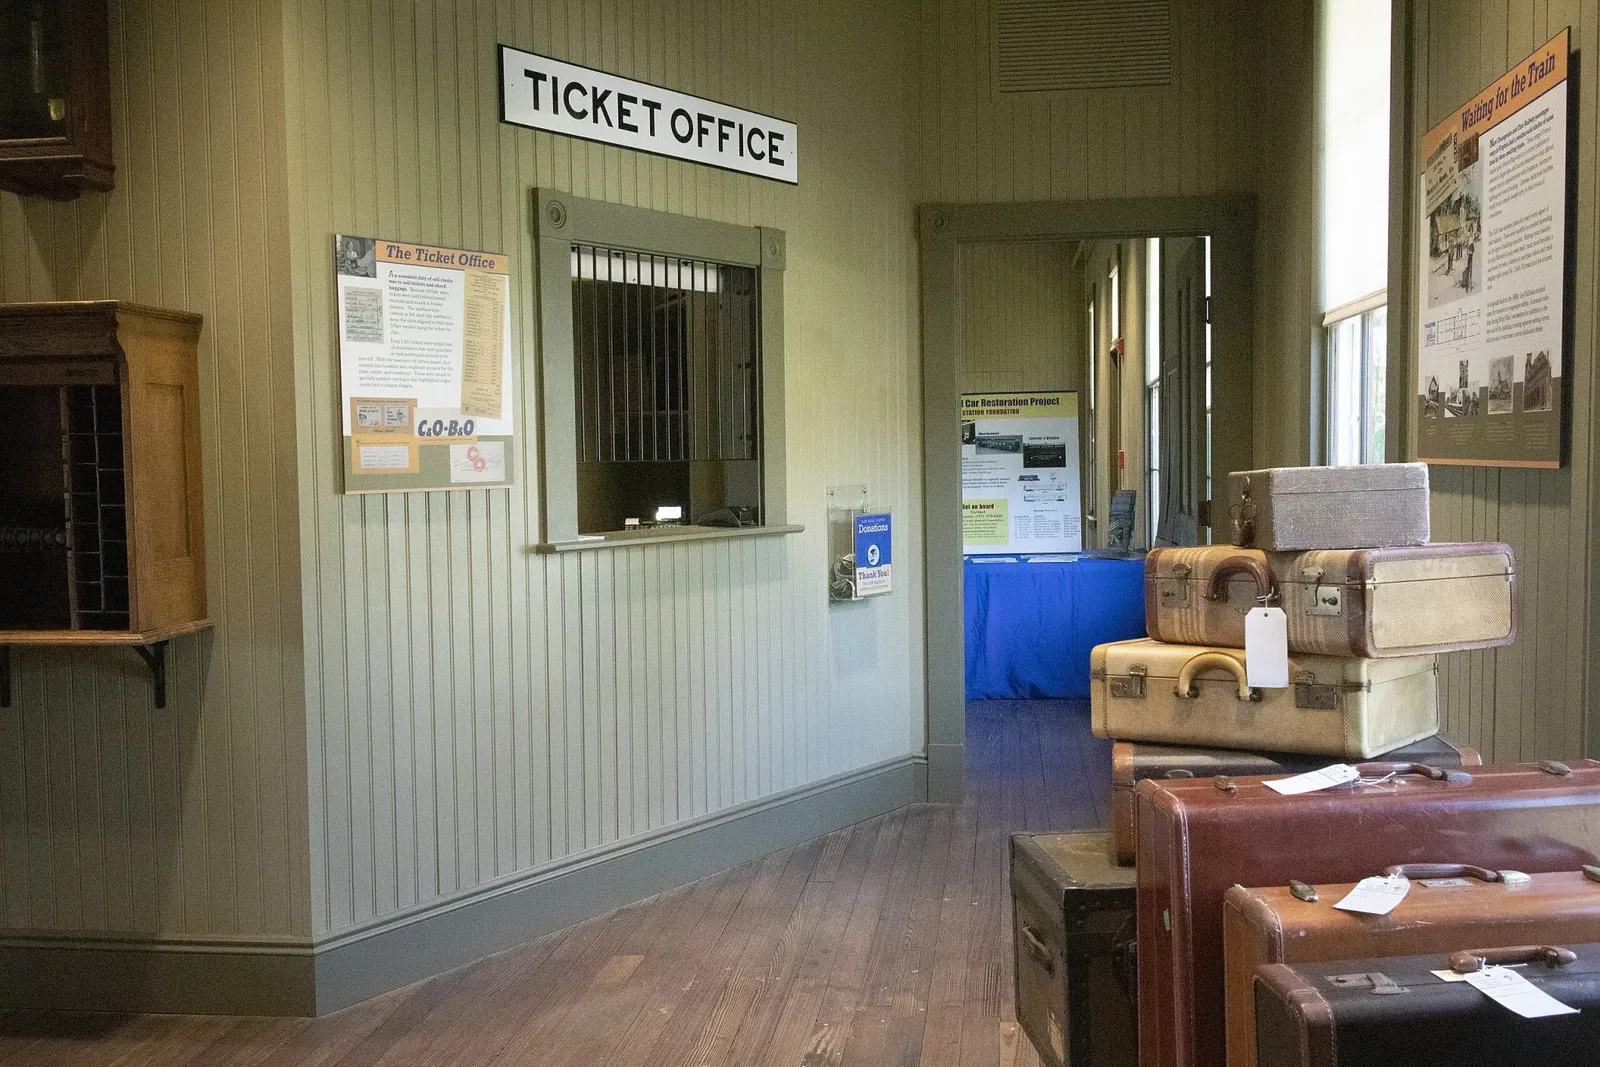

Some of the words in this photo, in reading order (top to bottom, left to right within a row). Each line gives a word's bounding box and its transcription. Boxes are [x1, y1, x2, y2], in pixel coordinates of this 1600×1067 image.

[1461, 99, 1494, 132] Waiting
[1494, 86, 1509, 110] for
[1510, 74, 1526, 100] the
[1527, 51, 1556, 88] Train
[524, 68, 661, 137] TICKET
[670, 108, 784, 166] OFFICE
[386, 245, 412, 260] The
[415, 248, 455, 265] Ticket
[458, 253, 496, 269] Office
[965, 399, 979, 408] Car
[981, 398, 1029, 407] Restoration
[1030, 397, 1060, 407] Project
[417, 419, 475, 437] C&O-B&O
[858, 523, 889, 534] Donations
[858, 570, 877, 580] Thank
[877, 568, 889, 577] You!
